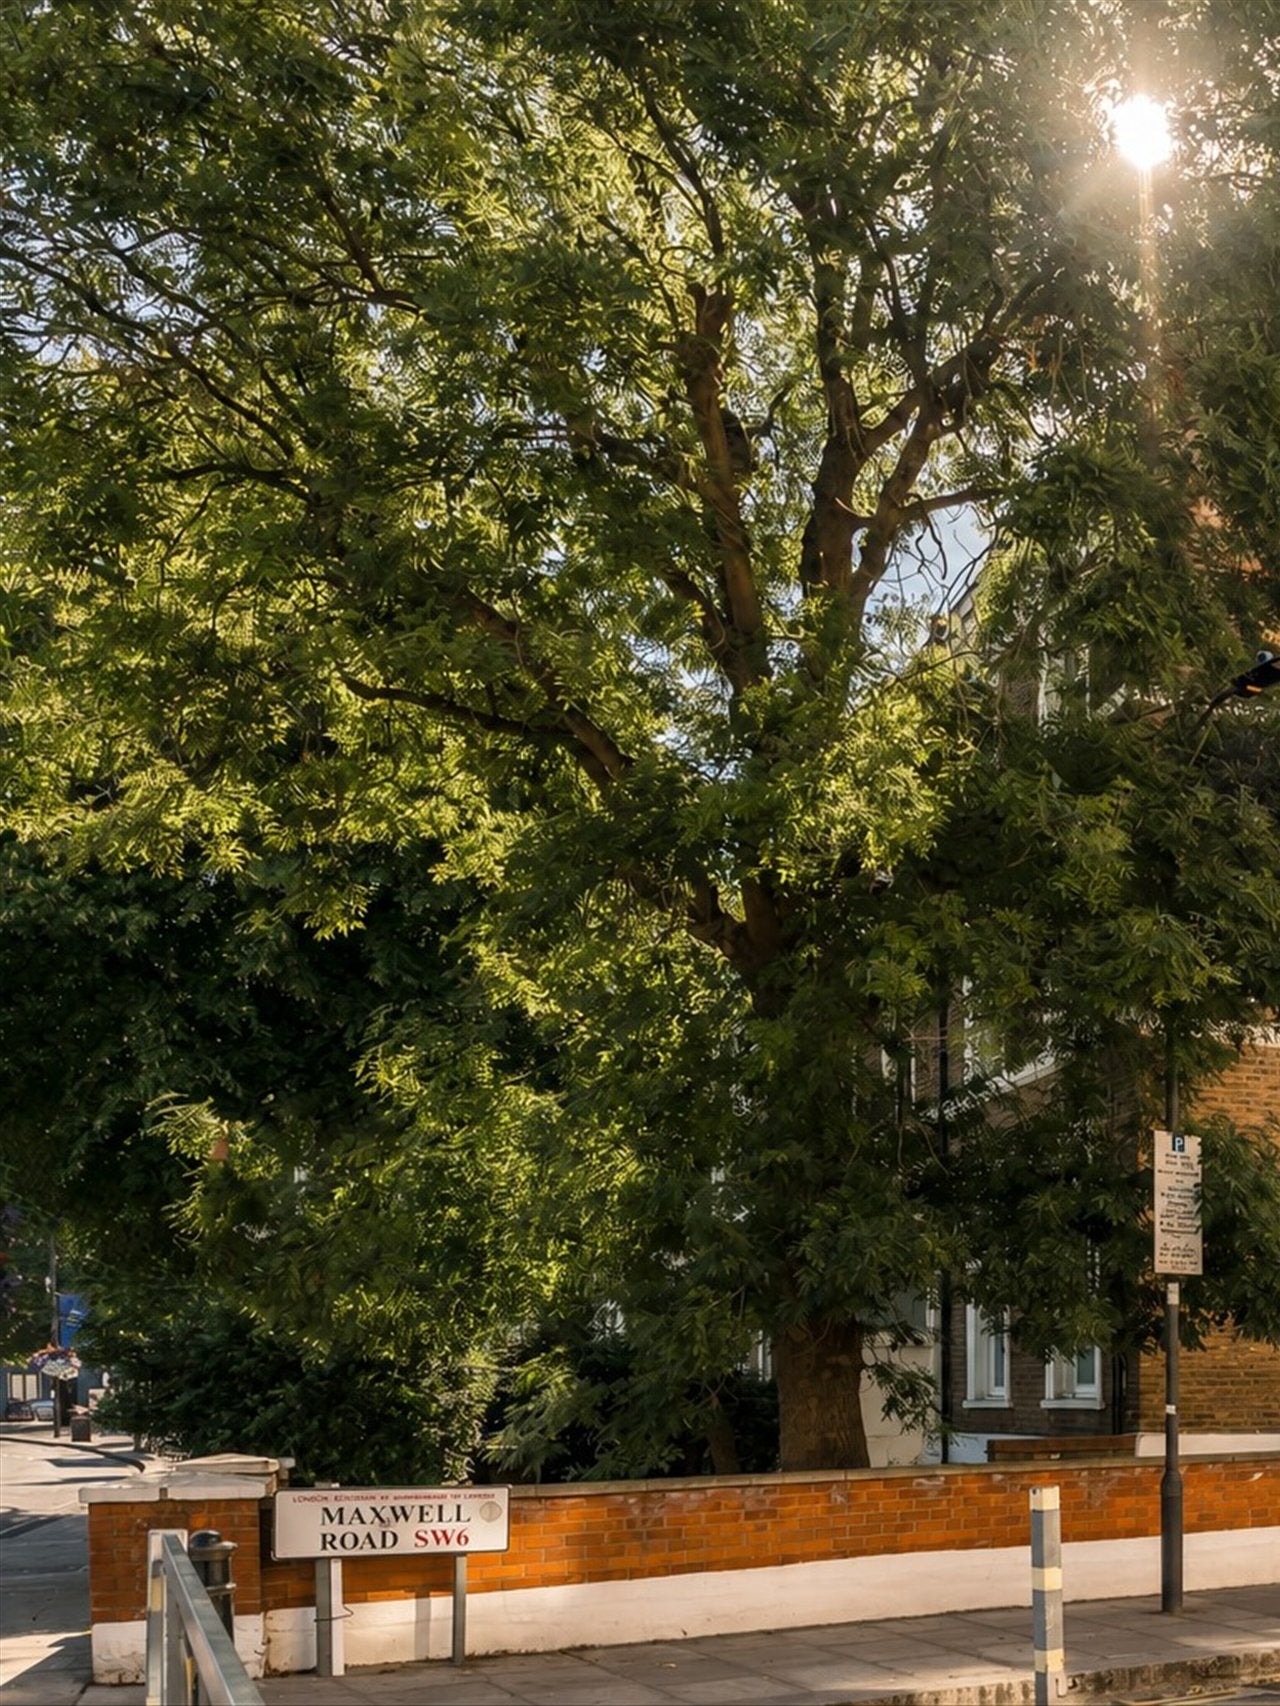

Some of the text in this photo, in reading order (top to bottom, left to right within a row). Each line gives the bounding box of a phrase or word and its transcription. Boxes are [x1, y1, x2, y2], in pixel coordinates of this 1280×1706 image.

[1174, 1136, 1183, 1152] P
[320, 1504, 471, 1526] MAXWELL
[320, 1528, 470, 1551] ROAD SW6
